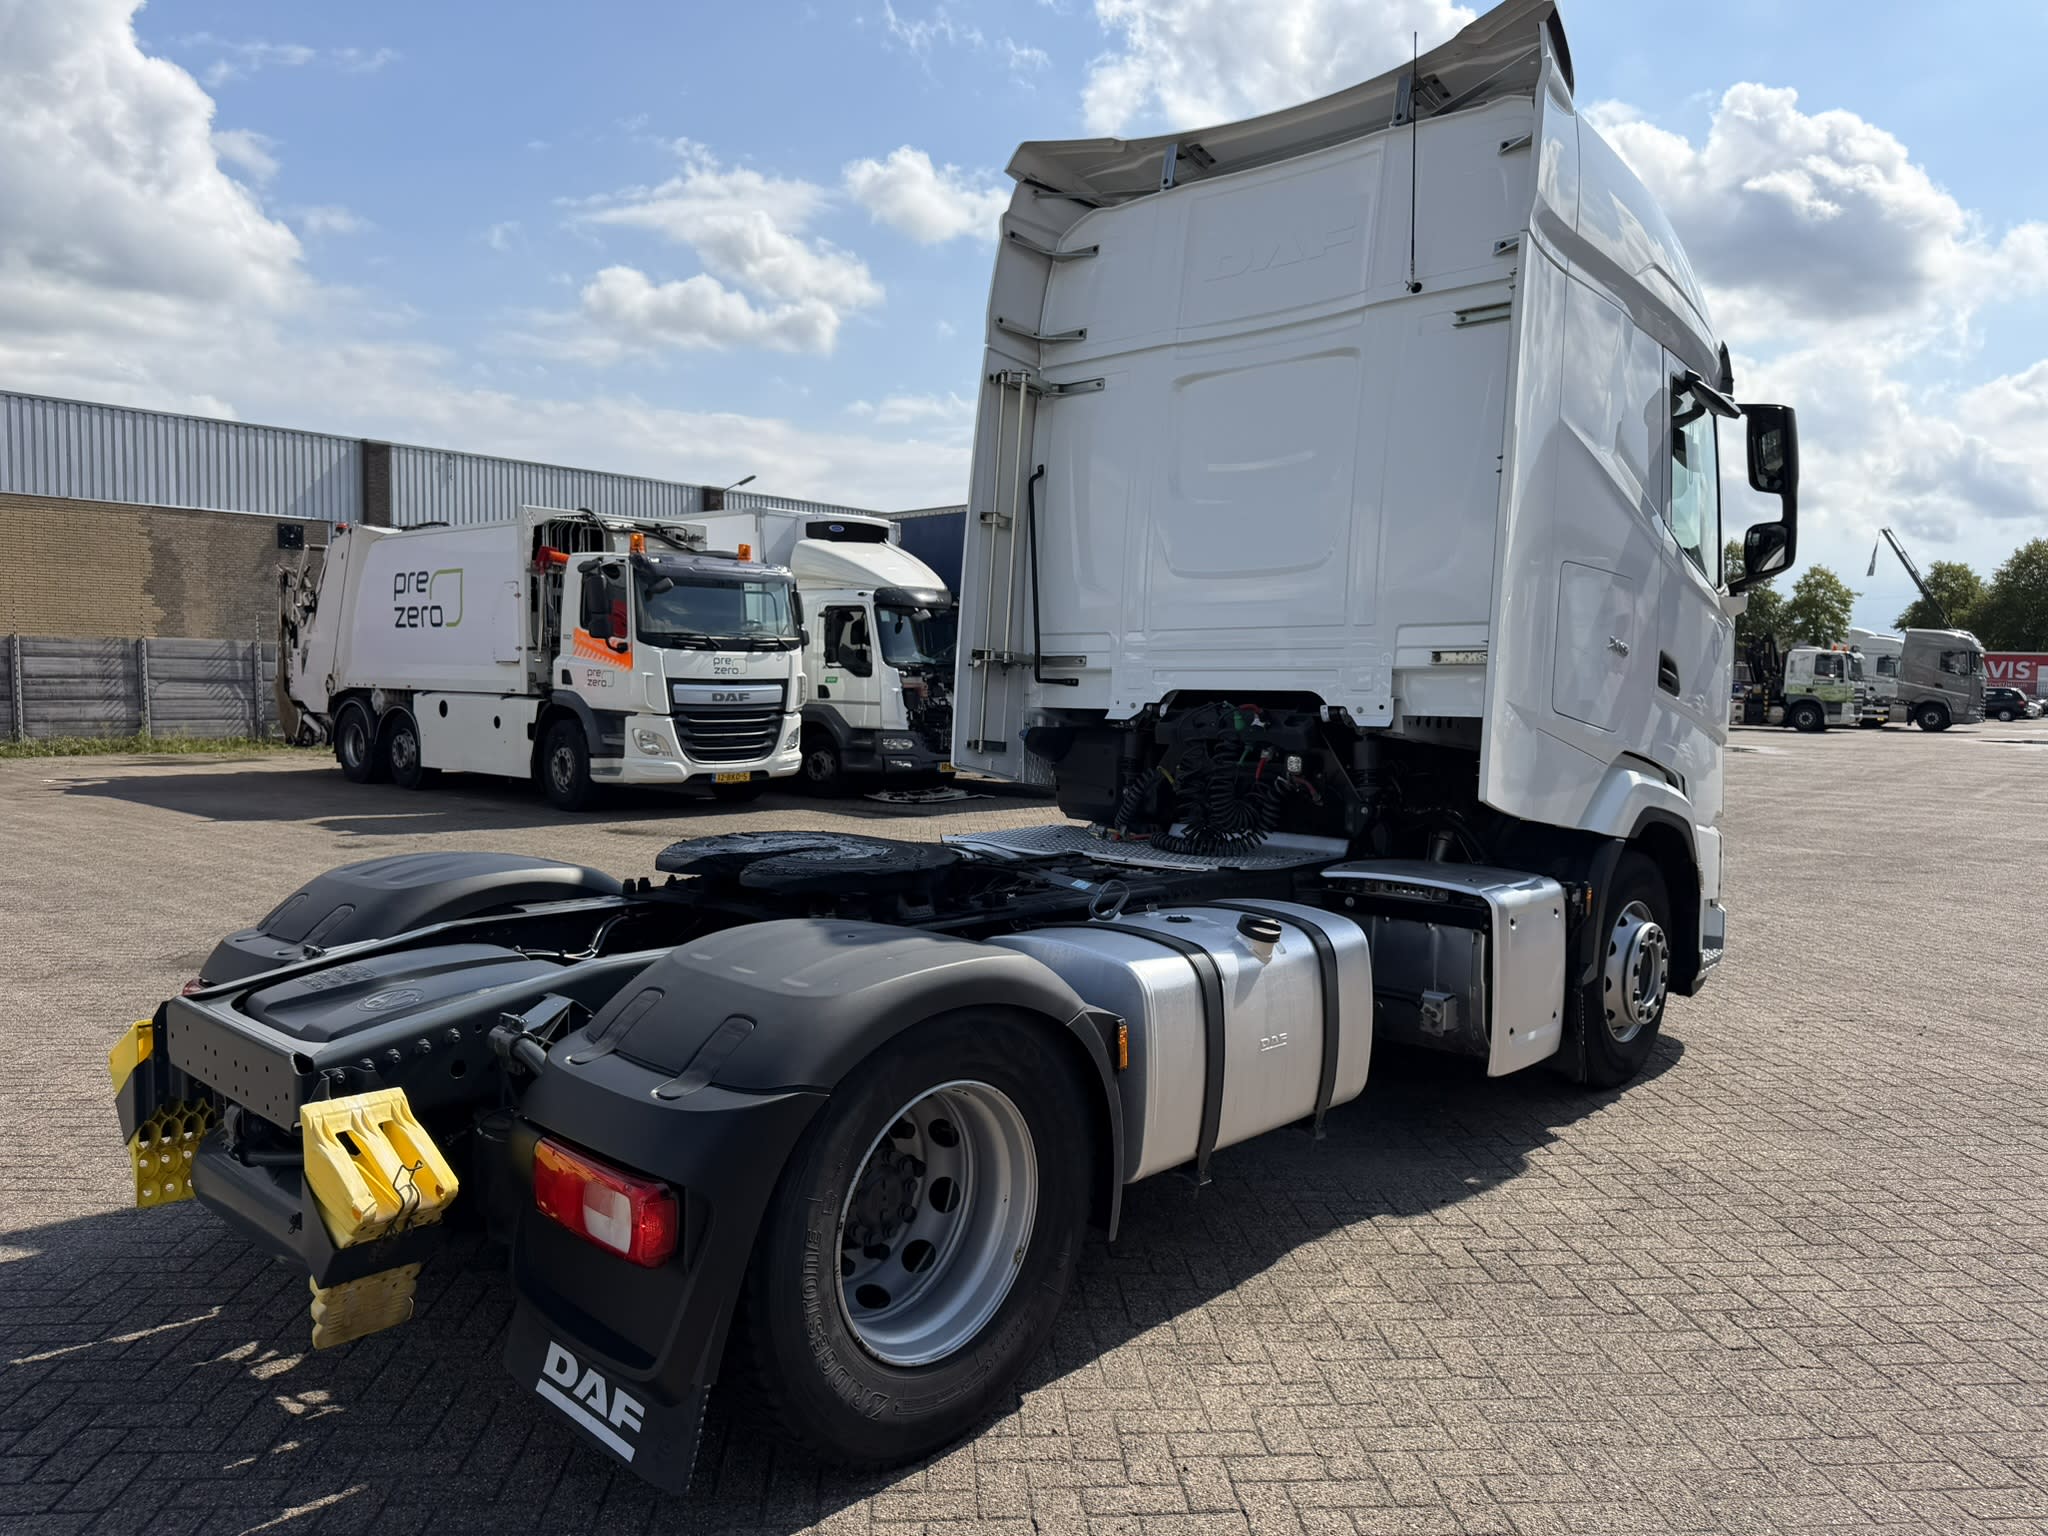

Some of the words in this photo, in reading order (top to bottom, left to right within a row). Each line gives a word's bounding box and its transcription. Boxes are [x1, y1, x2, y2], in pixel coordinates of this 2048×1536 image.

[393, 570, 429, 601] pre
[394, 605, 443, 628] zero
[712, 656, 732, 666] pre
[586, 669, 602, 678] pre
[714, 666, 740, 675] zero
[587, 679, 607, 688] zero
[711, 692, 751, 702] DAF
[803, 1228, 891, 1421] BRIDGESTONE
[542, 1340, 646, 1434] DAF
